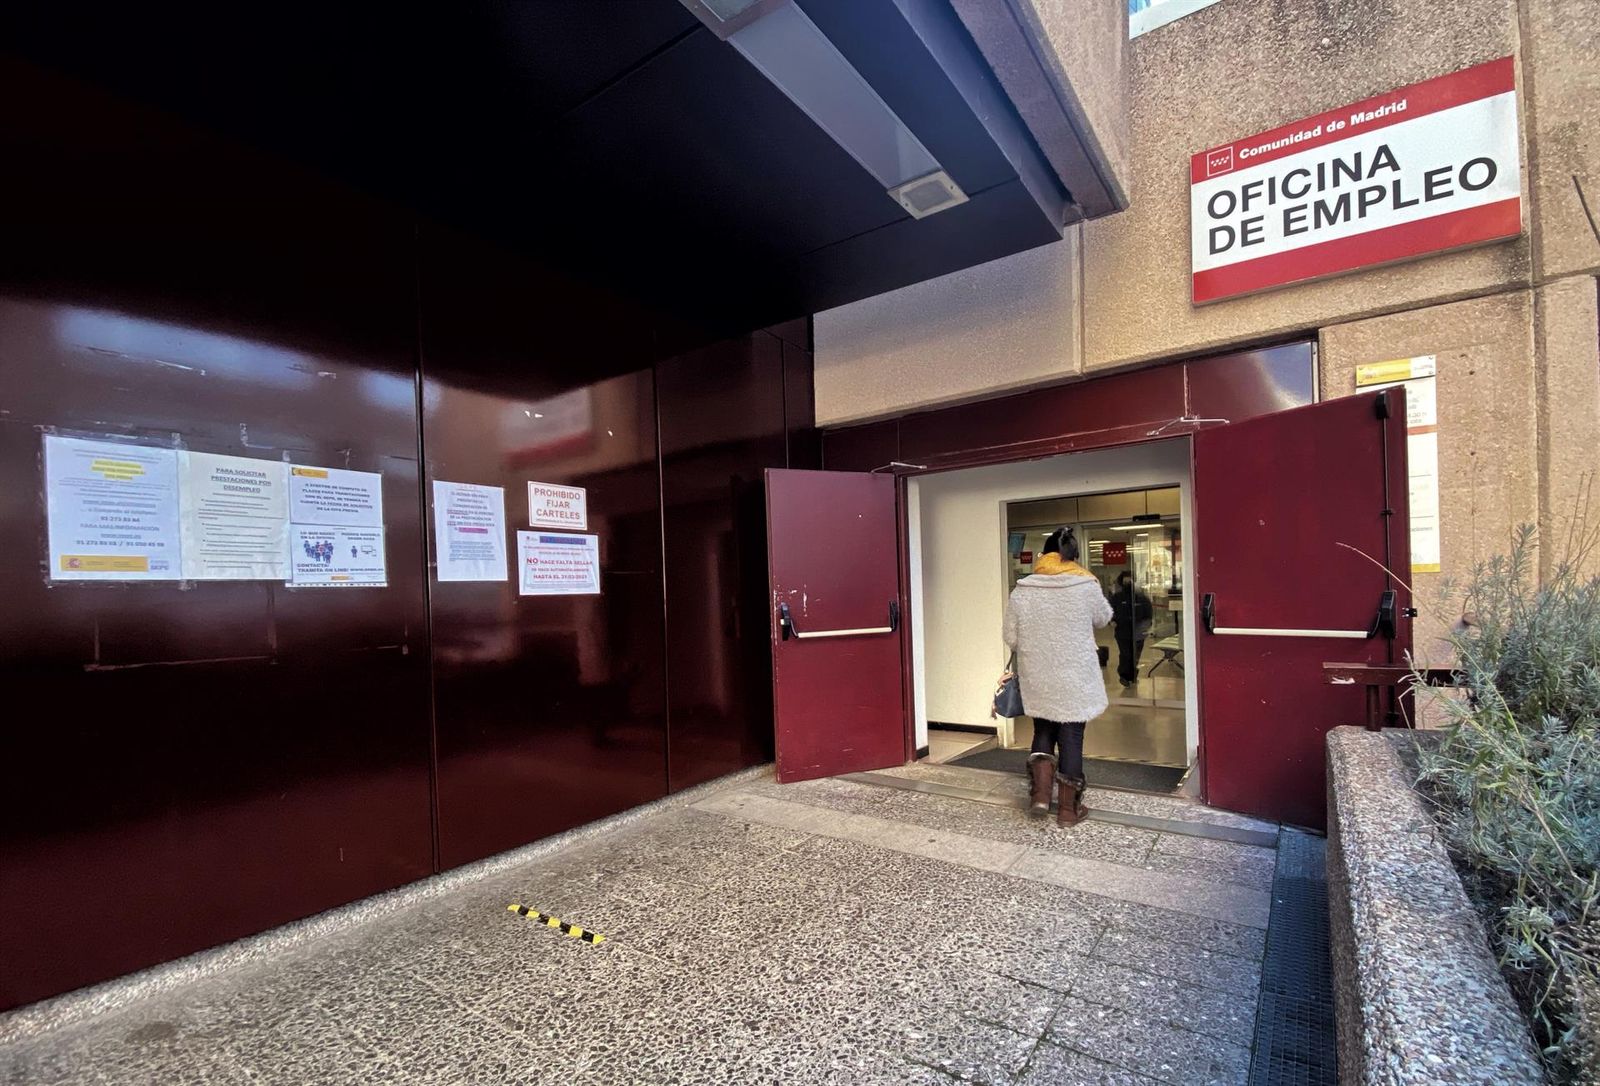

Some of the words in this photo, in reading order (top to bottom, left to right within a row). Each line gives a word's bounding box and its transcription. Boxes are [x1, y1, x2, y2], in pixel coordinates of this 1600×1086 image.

[1239, 125, 1322, 160] Comunidad
[1326, 117, 1346, 133] de
[1350, 99, 1407, 126] Madrid
[1207, 143, 1401, 220] OFICINA
[1208, 214, 1265, 255] DE
[1283, 156, 1498, 238] EMPLEO
[224, 484, 261, 493] DESEMPLEO
[534, 487, 581, 500] PROHIBIDO
[546, 499, 570, 509] FIJAR
[536, 508, 580, 520] CARTELES
